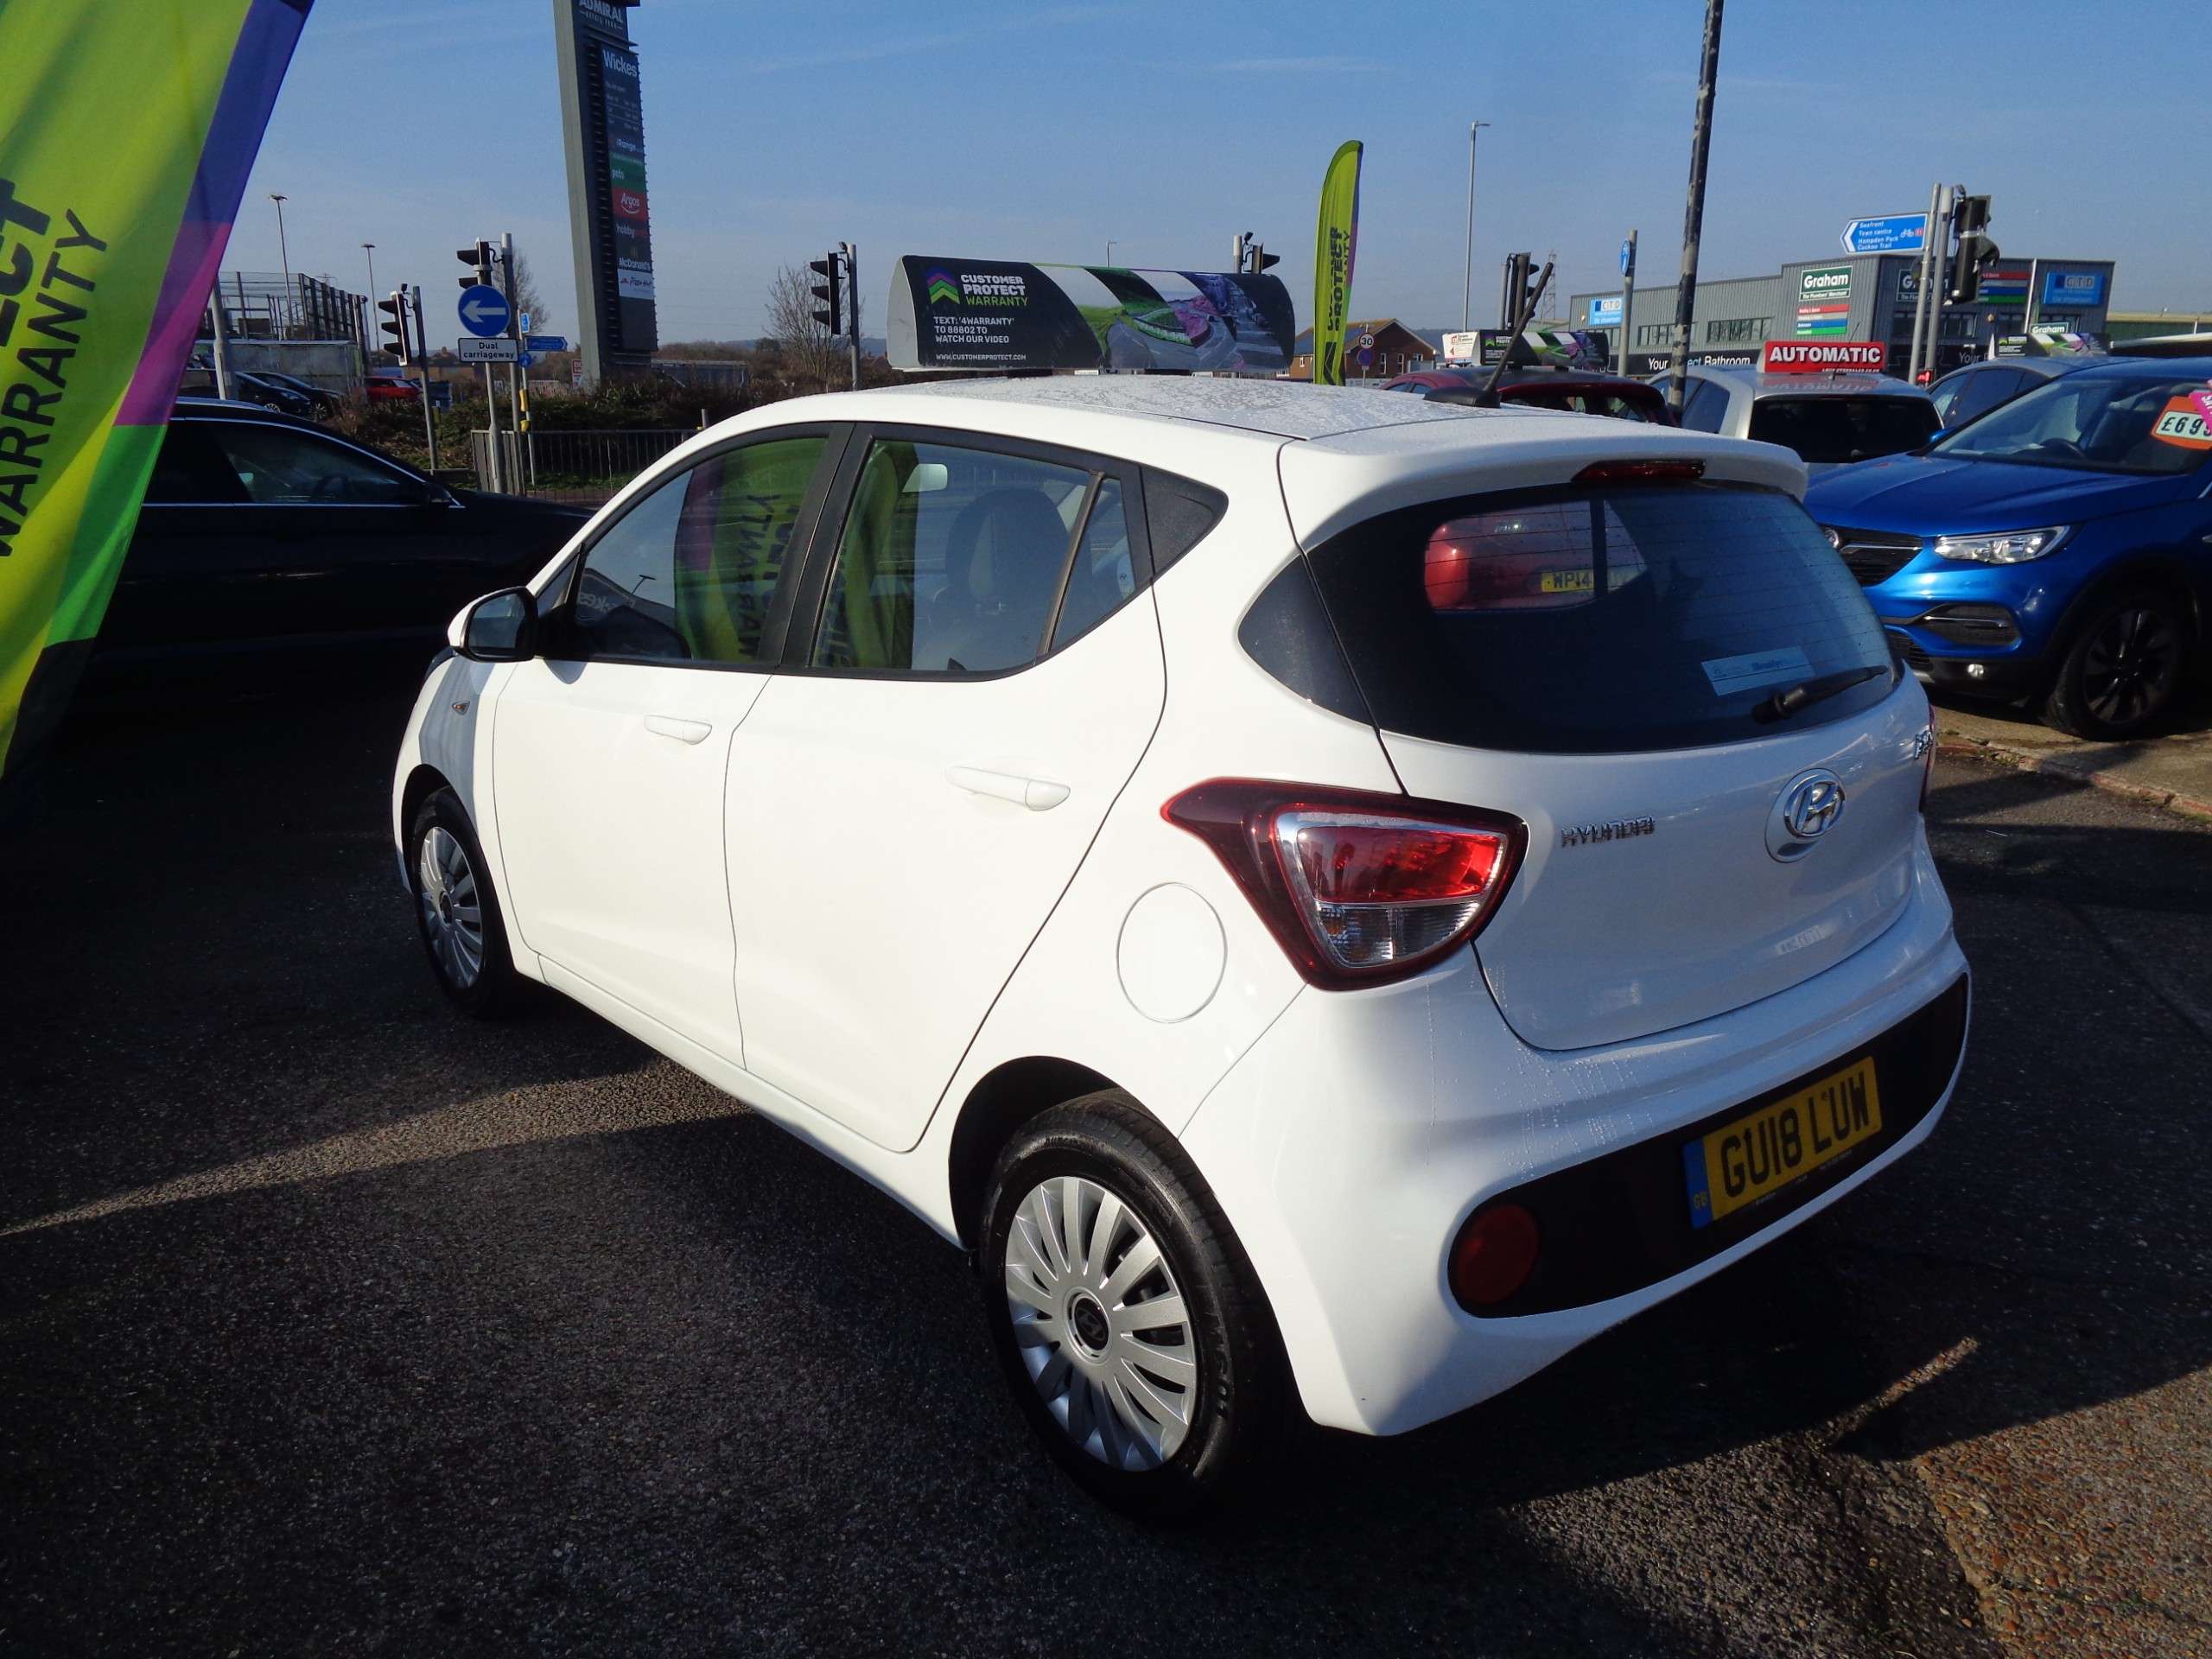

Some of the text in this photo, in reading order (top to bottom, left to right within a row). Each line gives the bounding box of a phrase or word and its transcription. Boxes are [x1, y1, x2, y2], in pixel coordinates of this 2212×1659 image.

[603, 49, 637, 77] Wickes
[621, 193, 640, 209] Argos
[961, 274, 1024, 284] CUSTOMER
[1804, 273, 1849, 289] Graham
[963, 283, 1026, 296] PROTECT
[966, 296, 1027, 306] WARRANTY
[933, 316, 958, 325] TEXT:
[2032, 325, 2065, 334] Graham
[984, 335, 1009, 344] VIDEO
[1361, 337, 1372, 346] 30
[463, 350, 515, 359] carriageway
[1770, 346, 1881, 363] AUTOMATIC
[1648, 357, 1669, 371] Your
[1704, 355, 1751, 366] Bathroom
[1561, 816, 1655, 848] HYUNDAI
[1720, 1071, 1870, 1198] GU18 LUW
